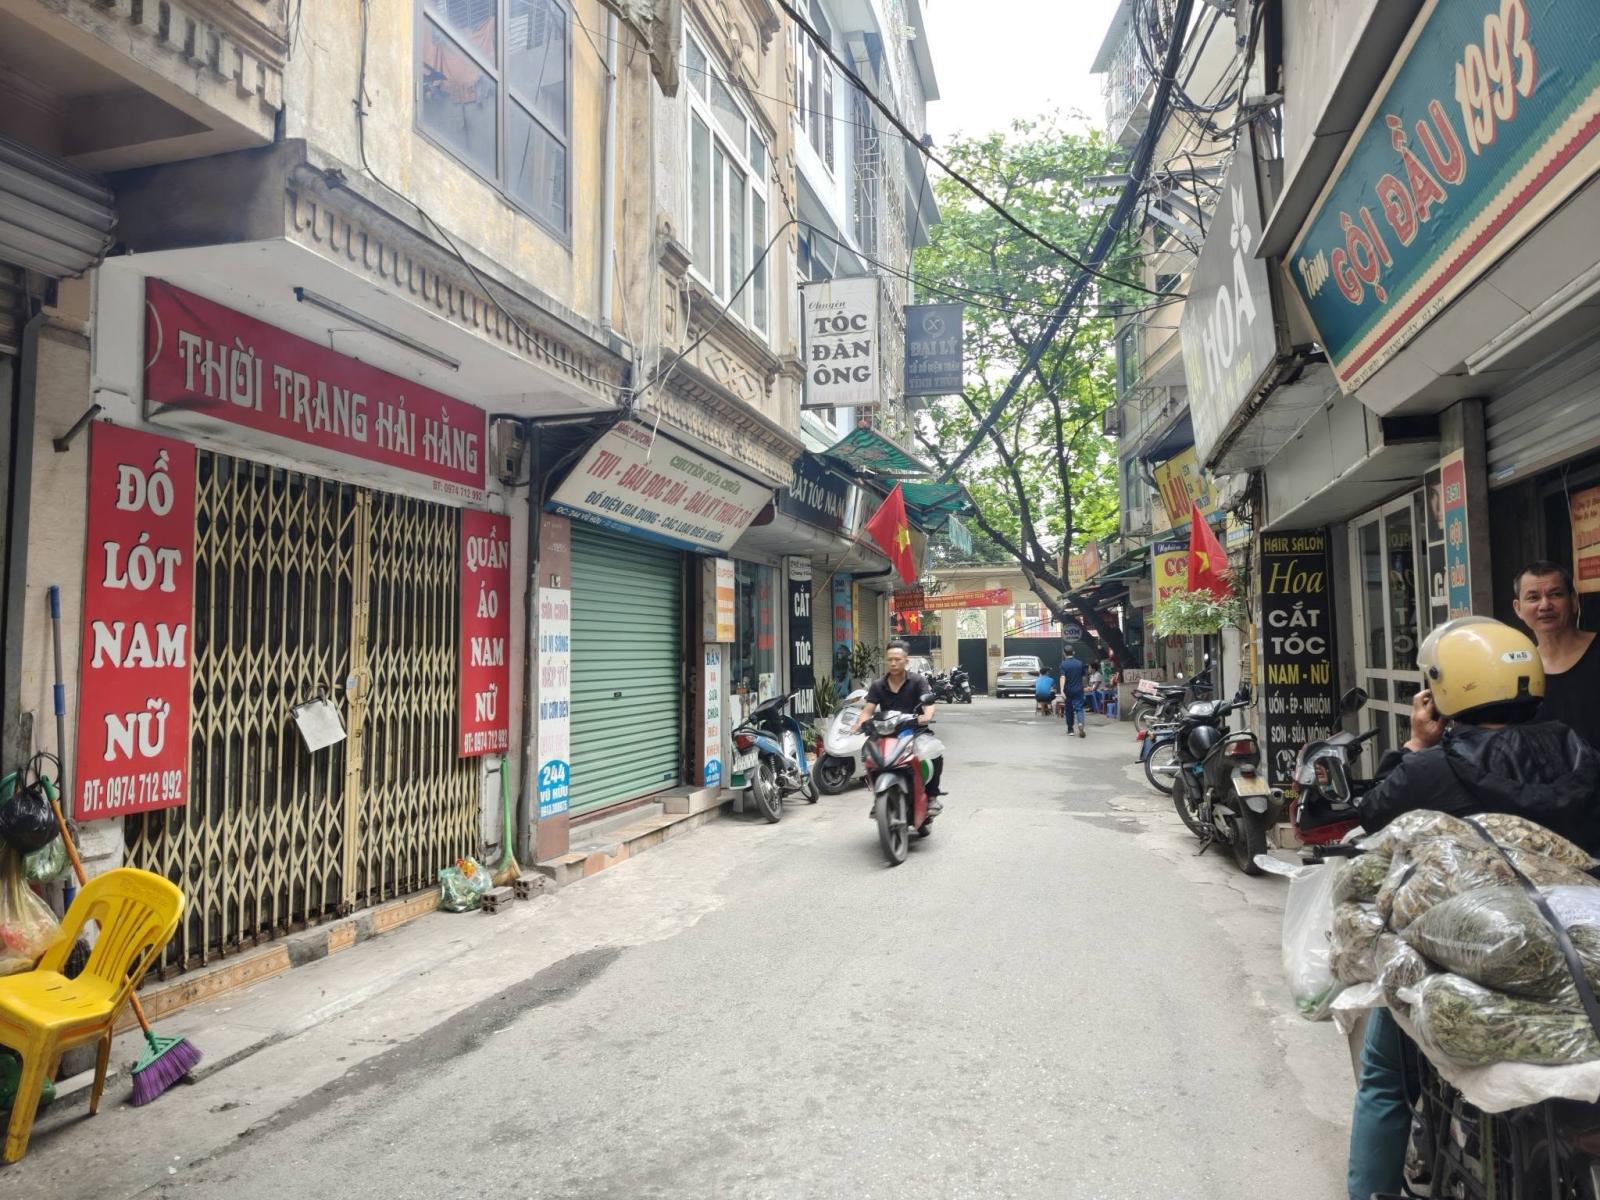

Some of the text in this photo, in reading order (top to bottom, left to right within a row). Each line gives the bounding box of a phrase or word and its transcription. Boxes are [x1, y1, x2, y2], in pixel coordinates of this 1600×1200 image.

[1331, 209, 1393, 305] GỘI
[1376, 99, 1466, 247] ĐẦU
[1455, 0, 1536, 156] 1993
[808, 301, 846, 312] Chuyên
[814, 310, 868, 334] TÓC
[1202, 246, 1257, 395] HOA
[812, 338, 871, 361] ĐÀN
[813, 363, 872, 386] ÔNG
[178, 329, 478, 475] THỜI TRANG HẢI HẰNG
[116, 449, 174, 516] ĐỒ
[444, 483, 459, 495] 0974
[460, 486, 471, 499] 712
[584, 490, 607, 505] ĐỒ
[599, 497, 625, 513] ĐIỆN
[620, 503, 636, 518] GIA
[635, 508, 660, 524] DỤNG
[467, 525, 508, 571] QUẦN
[1264, 536, 1324, 553] HAIR SALON
[102, 532, 182, 592] LÓT
[1267, 560, 1325, 594] Hoa
[477, 581, 499, 619] ÁO
[794, 584, 810, 617] CẮT
[1268, 601, 1321, 628] CẮT
[91, 621, 187, 669] NAM
[470, 637, 504, 667] NAM
[795, 636, 811, 666] TÓC
[1271, 632, 1326, 655] TÓC
[1268, 659, 1330, 685] NAM NỮ
[475, 683, 498, 723] NỮ
[794, 688, 814, 714] NAM
[1269, 690, 1285, 714] UỐN
[1303, 693, 1331, 718] NHUỘM
[104, 697, 170, 761] NỮ
[543, 763, 566, 786] 244
[83, 769, 182, 813] ĐT: 0974 712 992
